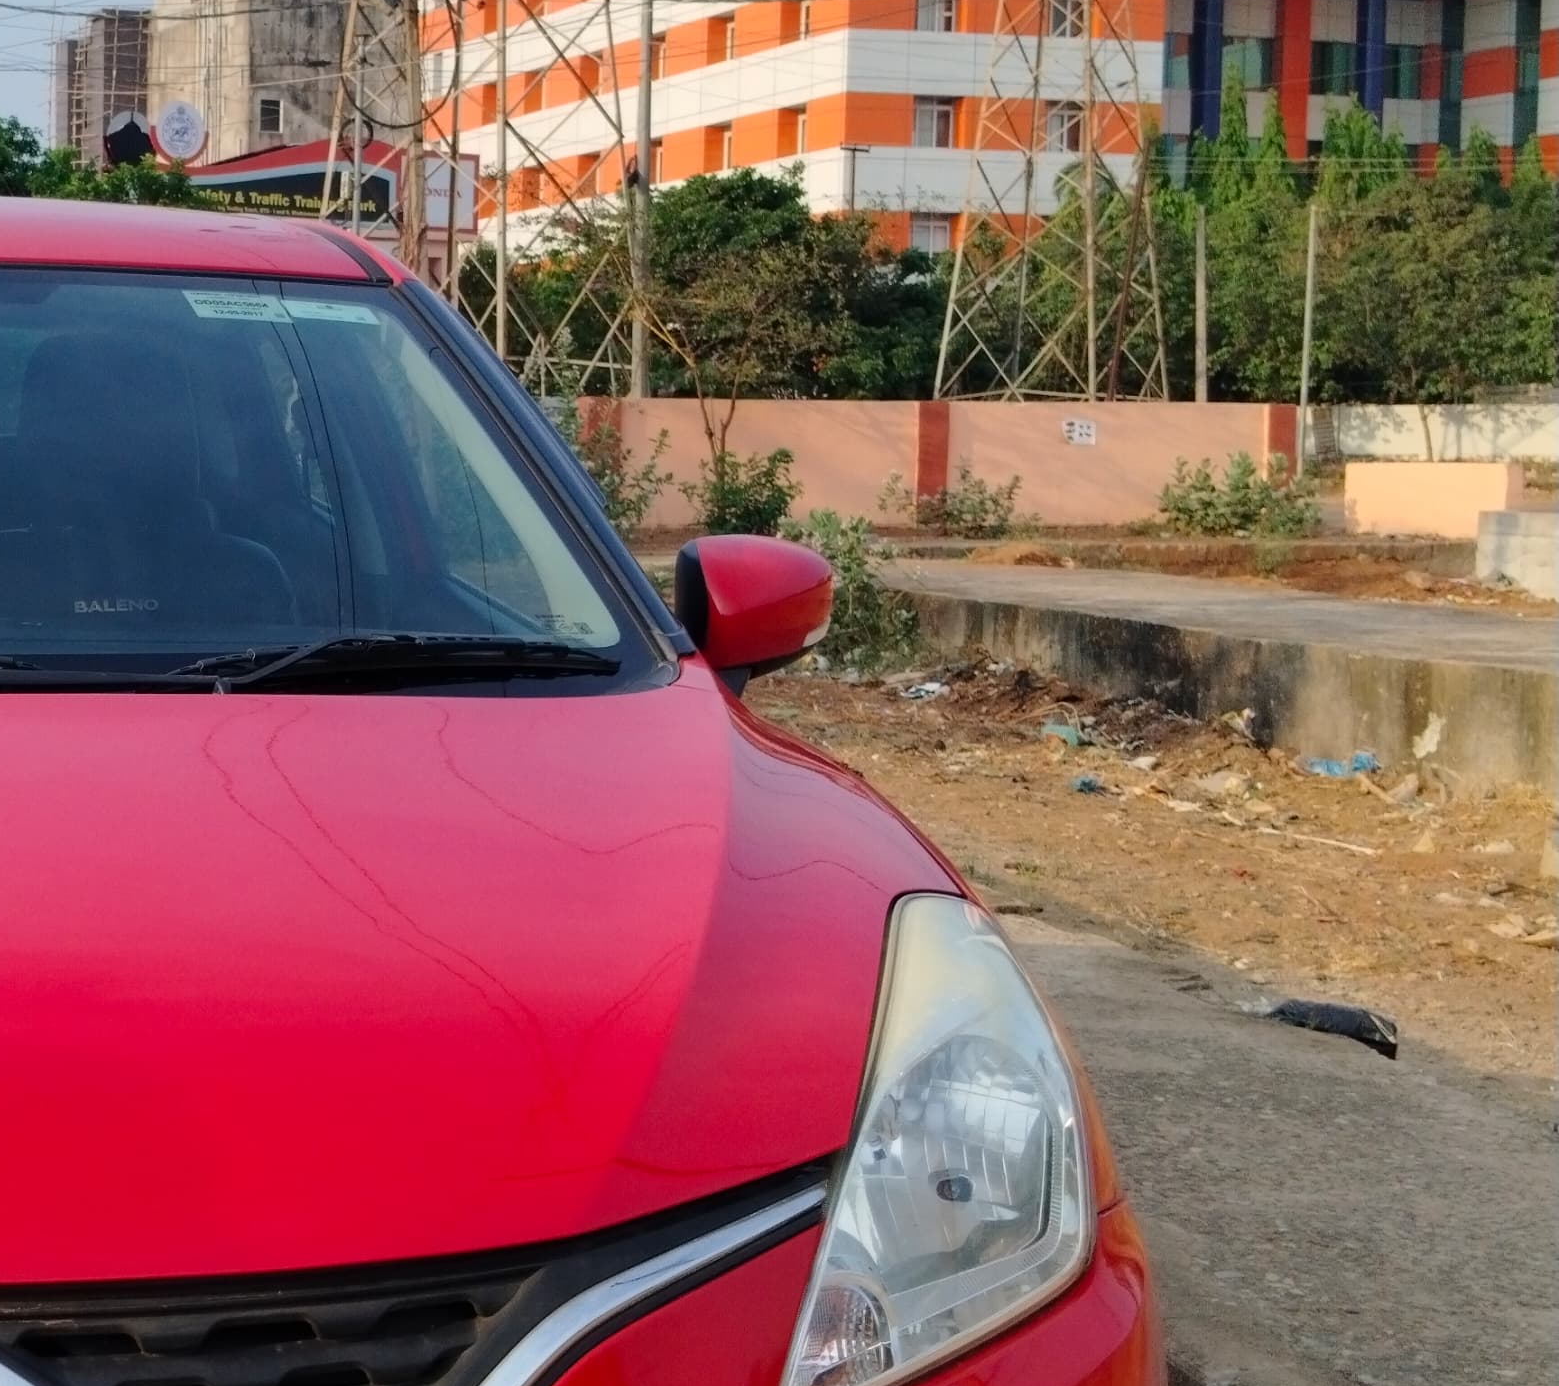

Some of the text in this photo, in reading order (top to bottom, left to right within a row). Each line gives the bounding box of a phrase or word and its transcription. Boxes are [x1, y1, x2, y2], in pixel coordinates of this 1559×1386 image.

[197, 188, 232, 206] afety
[248, 191, 290, 207] Traffic
[423, 186, 463, 199] ONDA
[73, 598, 160, 614] BALENO
